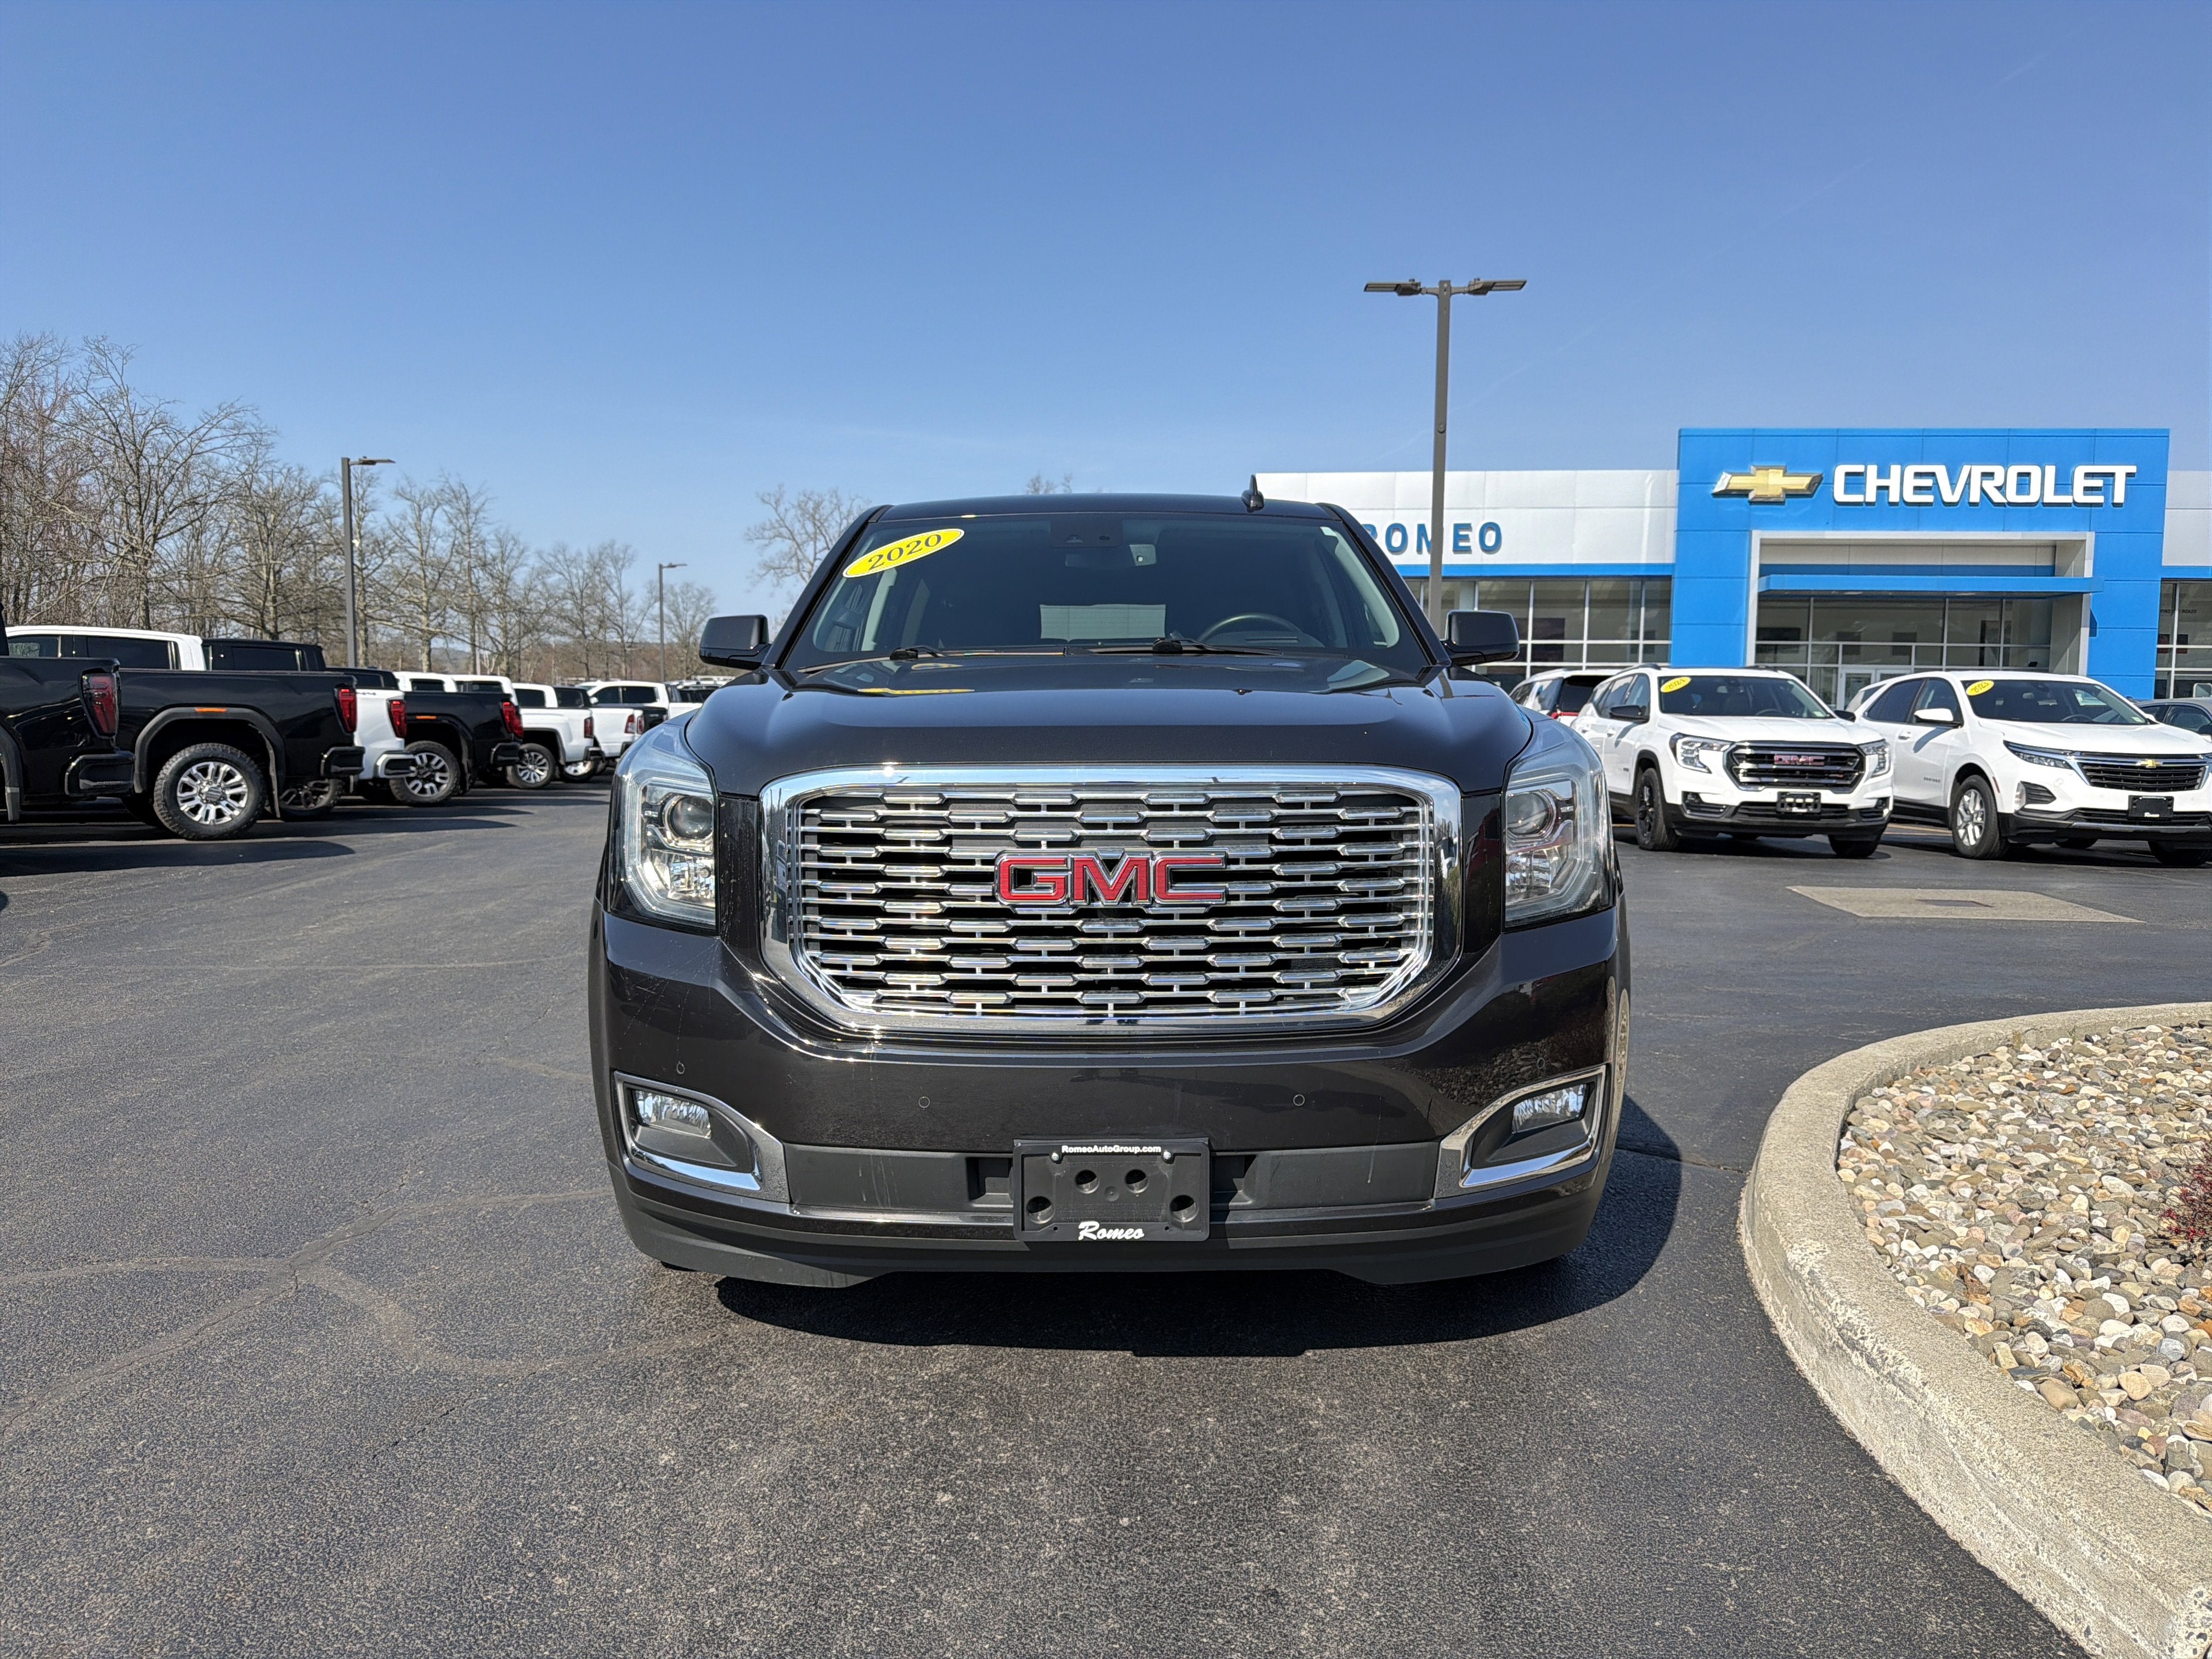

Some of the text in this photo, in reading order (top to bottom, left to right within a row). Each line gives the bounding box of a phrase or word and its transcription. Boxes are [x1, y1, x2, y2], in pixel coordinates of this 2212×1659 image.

[1833, 465, 2137, 505] CHEVROLET
[868, 534, 941, 571] 2020
[1774, 755, 1825, 766] GMC
[995, 848, 1229, 906] GMC
[1062, 1144, 1161, 1154] RomeoAutoGroup.com
[1078, 1221, 1144, 1241] Romeo
